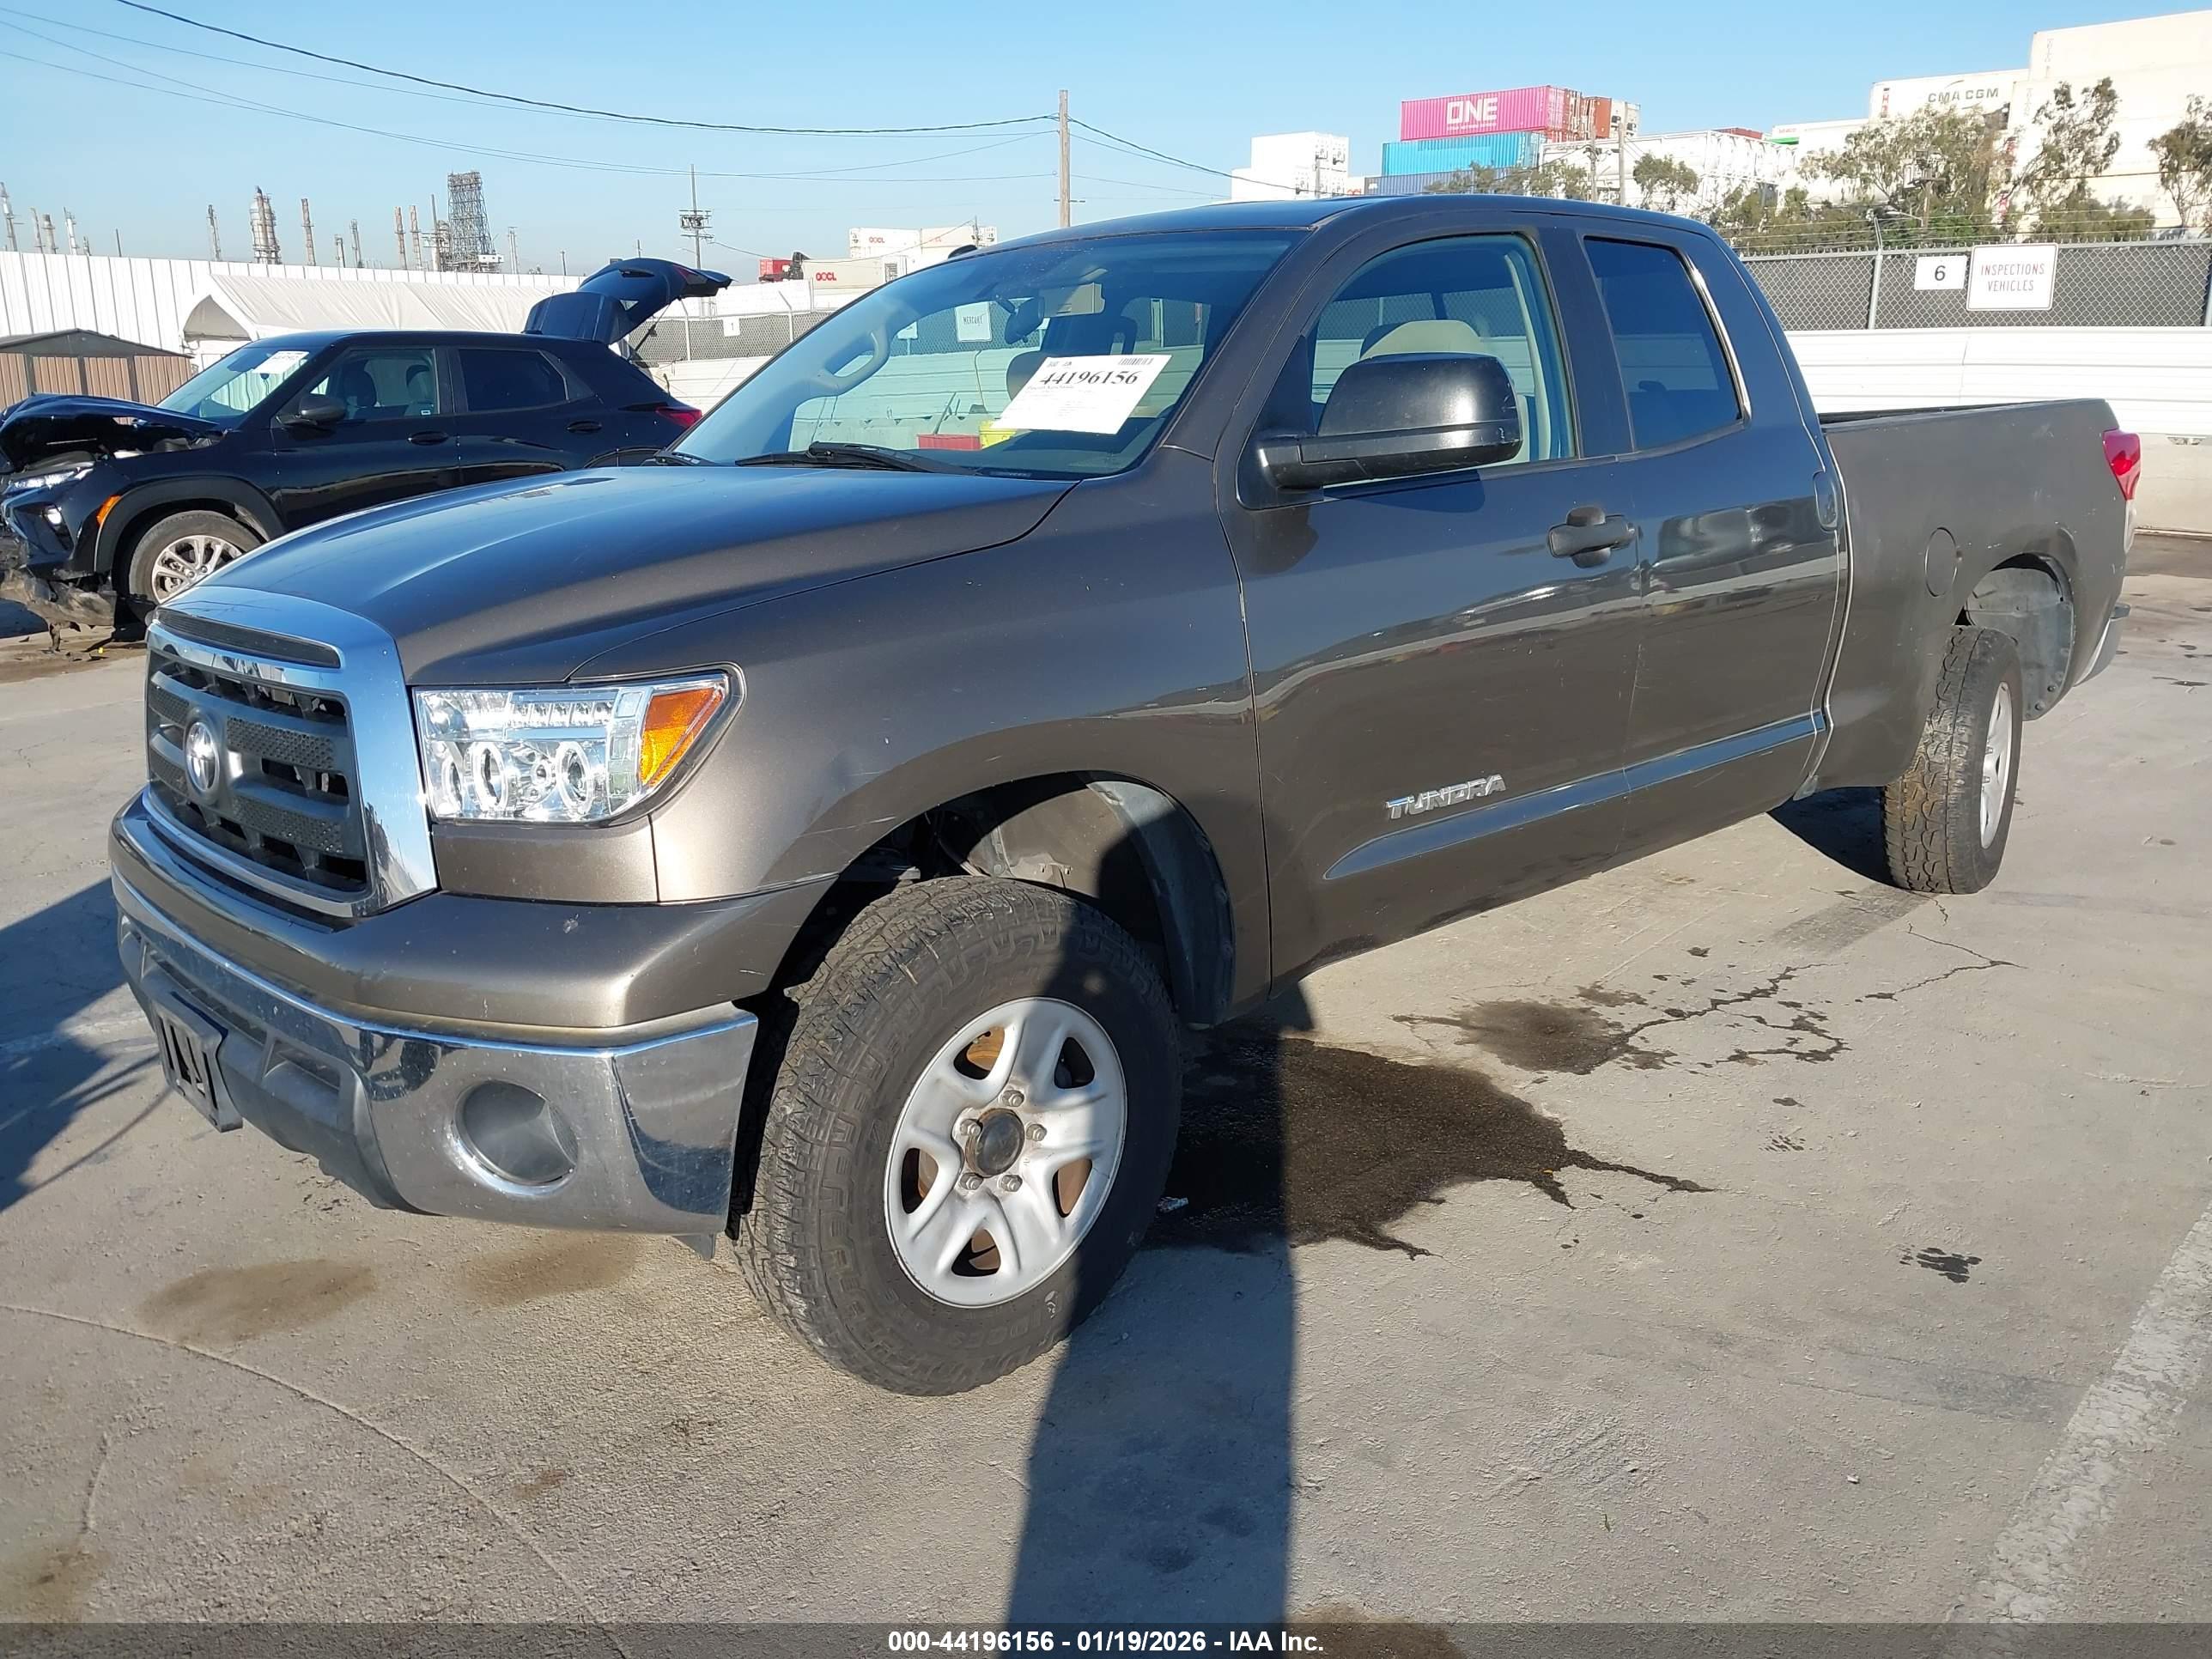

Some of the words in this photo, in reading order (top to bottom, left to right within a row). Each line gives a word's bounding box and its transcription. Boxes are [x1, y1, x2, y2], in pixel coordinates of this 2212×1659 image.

[1928, 91, 1960, 103] CMA
[1965, 88, 1999, 100] CGM
[1446, 96, 1498, 125] ONE
[816, 271, 836, 282] OOCL
[1934, 264, 1946, 281] 6
[1980, 263, 2045, 276] INSPECTIONS
[1988, 279, 2034, 291] VEHICLES
[1040, 370, 1142, 385] 44196156
[1386, 774, 1506, 819] TUNDRA
